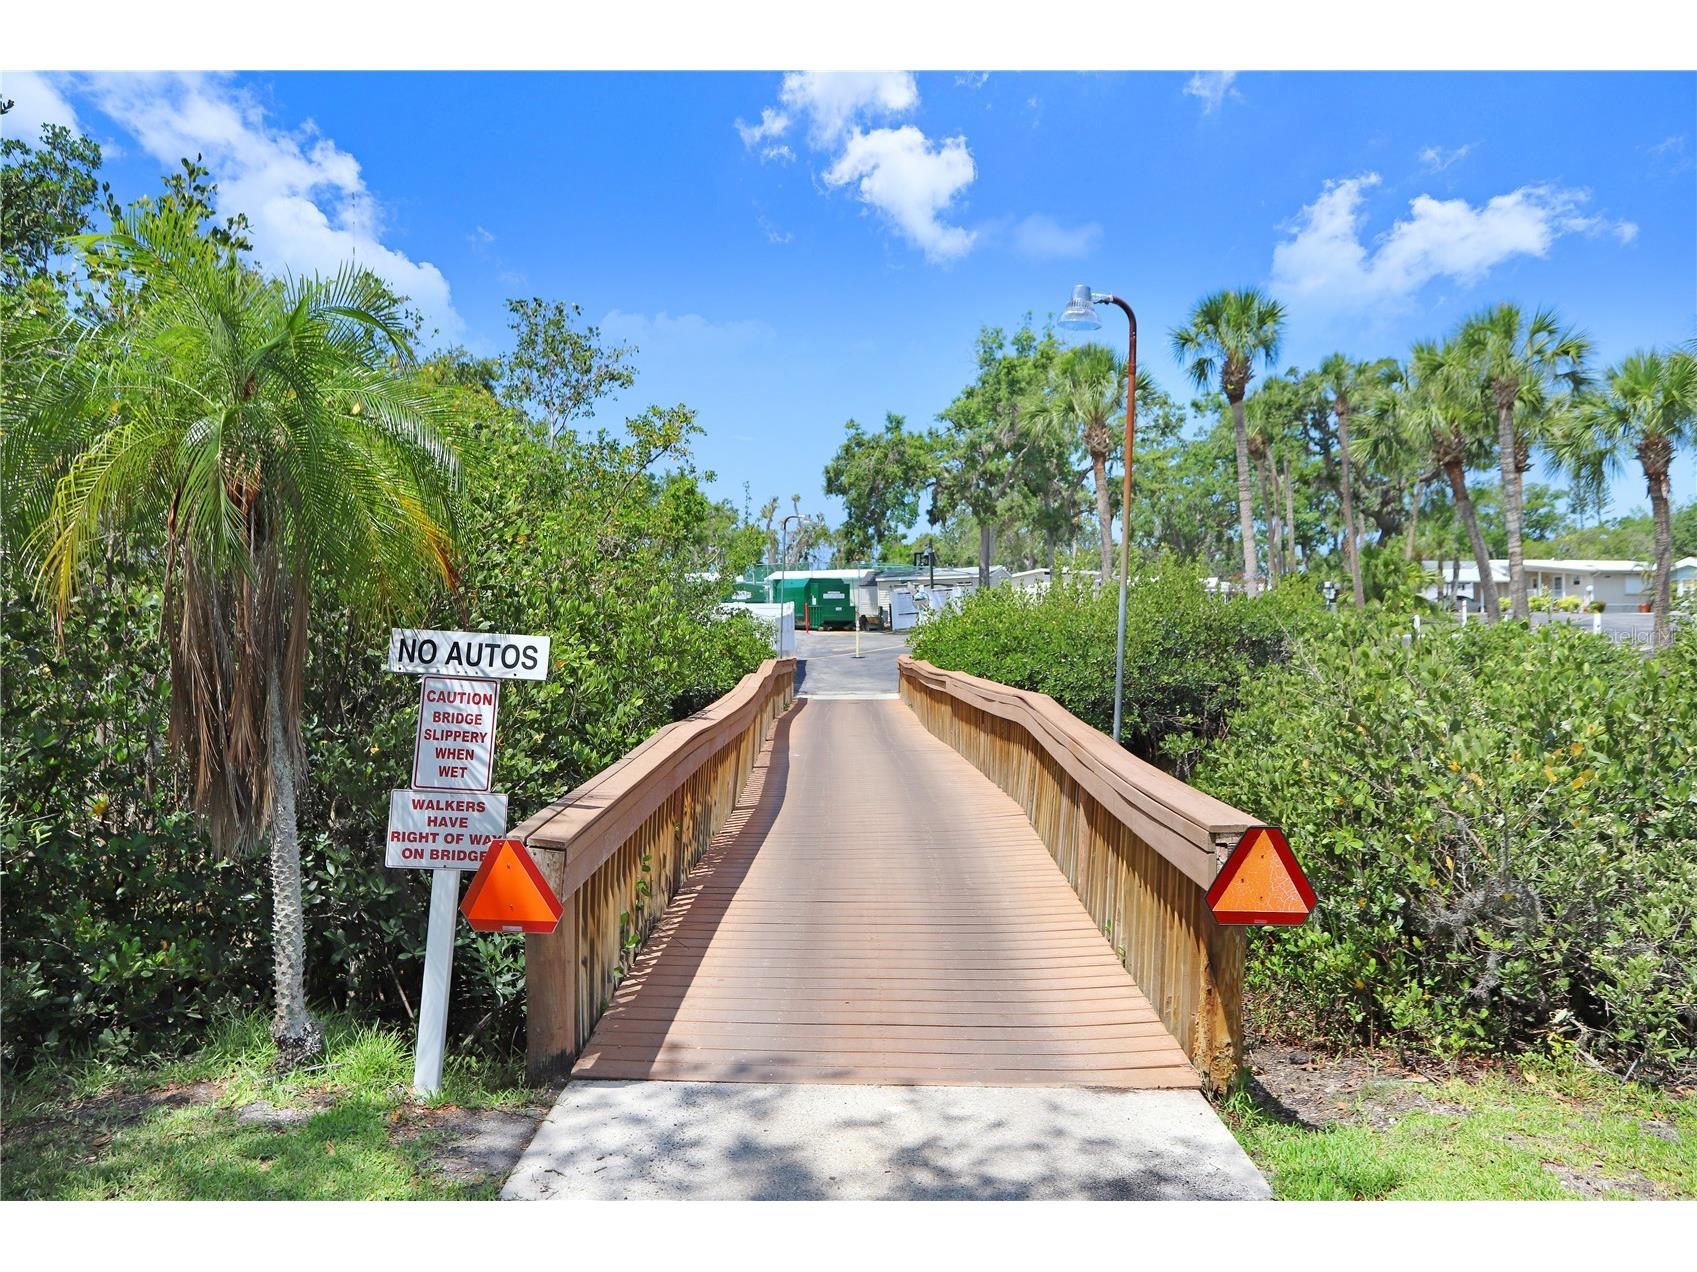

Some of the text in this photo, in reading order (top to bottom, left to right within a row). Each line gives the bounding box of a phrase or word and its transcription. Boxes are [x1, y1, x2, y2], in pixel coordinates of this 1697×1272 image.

[398, 639, 538, 670] NO AUTOS
[426, 690, 493, 706] CAUTION
[432, 711, 482, 726] BRIDGE
[424, 729, 487, 744] SLIPPERY
[435, 747, 474, 761] WHEN
[438, 765, 468, 779] WET
[412, 799, 486, 812] WALKERS
[427, 816, 468, 828] HAVE
[390, 831, 439, 844] RIGHT
[444, 833, 464, 844] OF
[401, 848, 424, 860] ON
